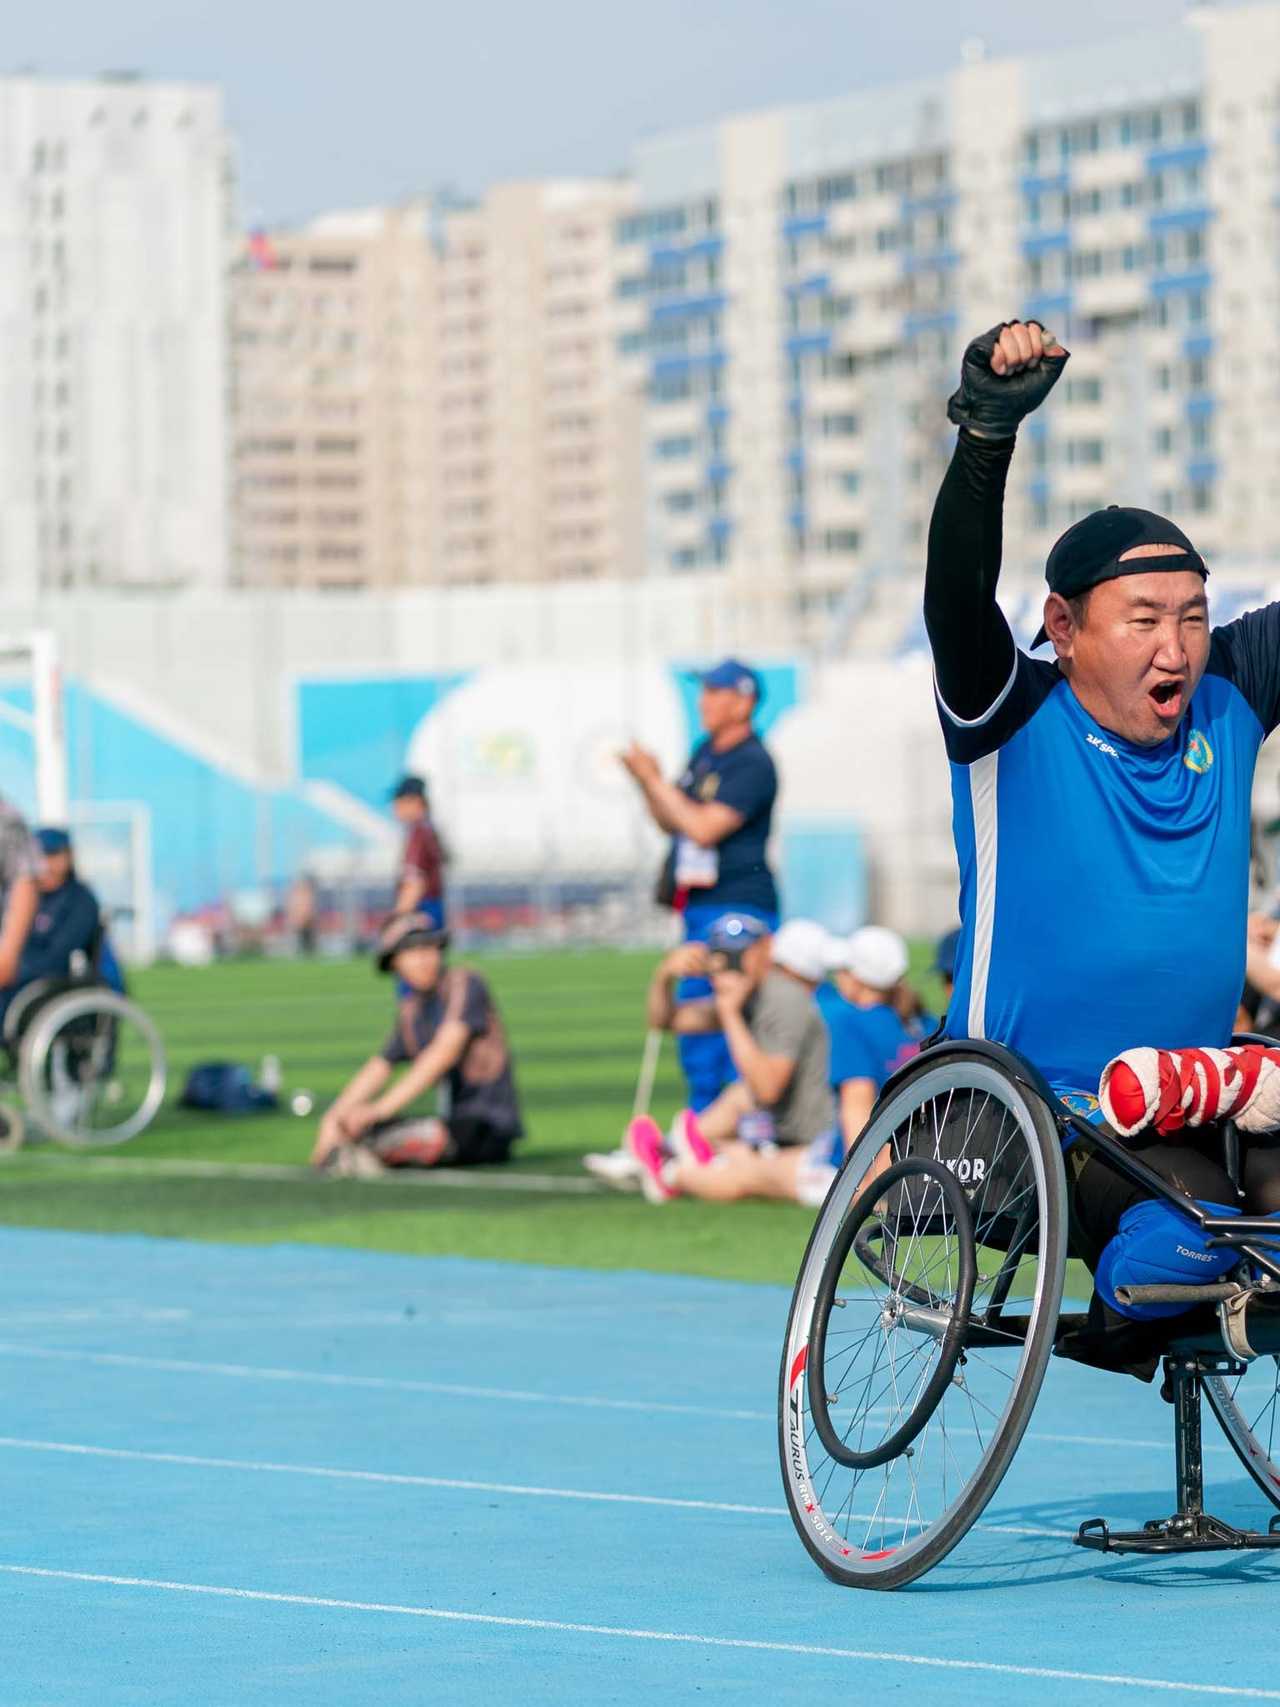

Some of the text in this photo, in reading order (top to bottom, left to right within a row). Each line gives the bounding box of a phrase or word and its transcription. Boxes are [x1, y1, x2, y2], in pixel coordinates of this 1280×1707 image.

[1176, 1244, 1213, 1262] TORRES
[790, 1388, 833, 1542] TAURUS RMX 5014
